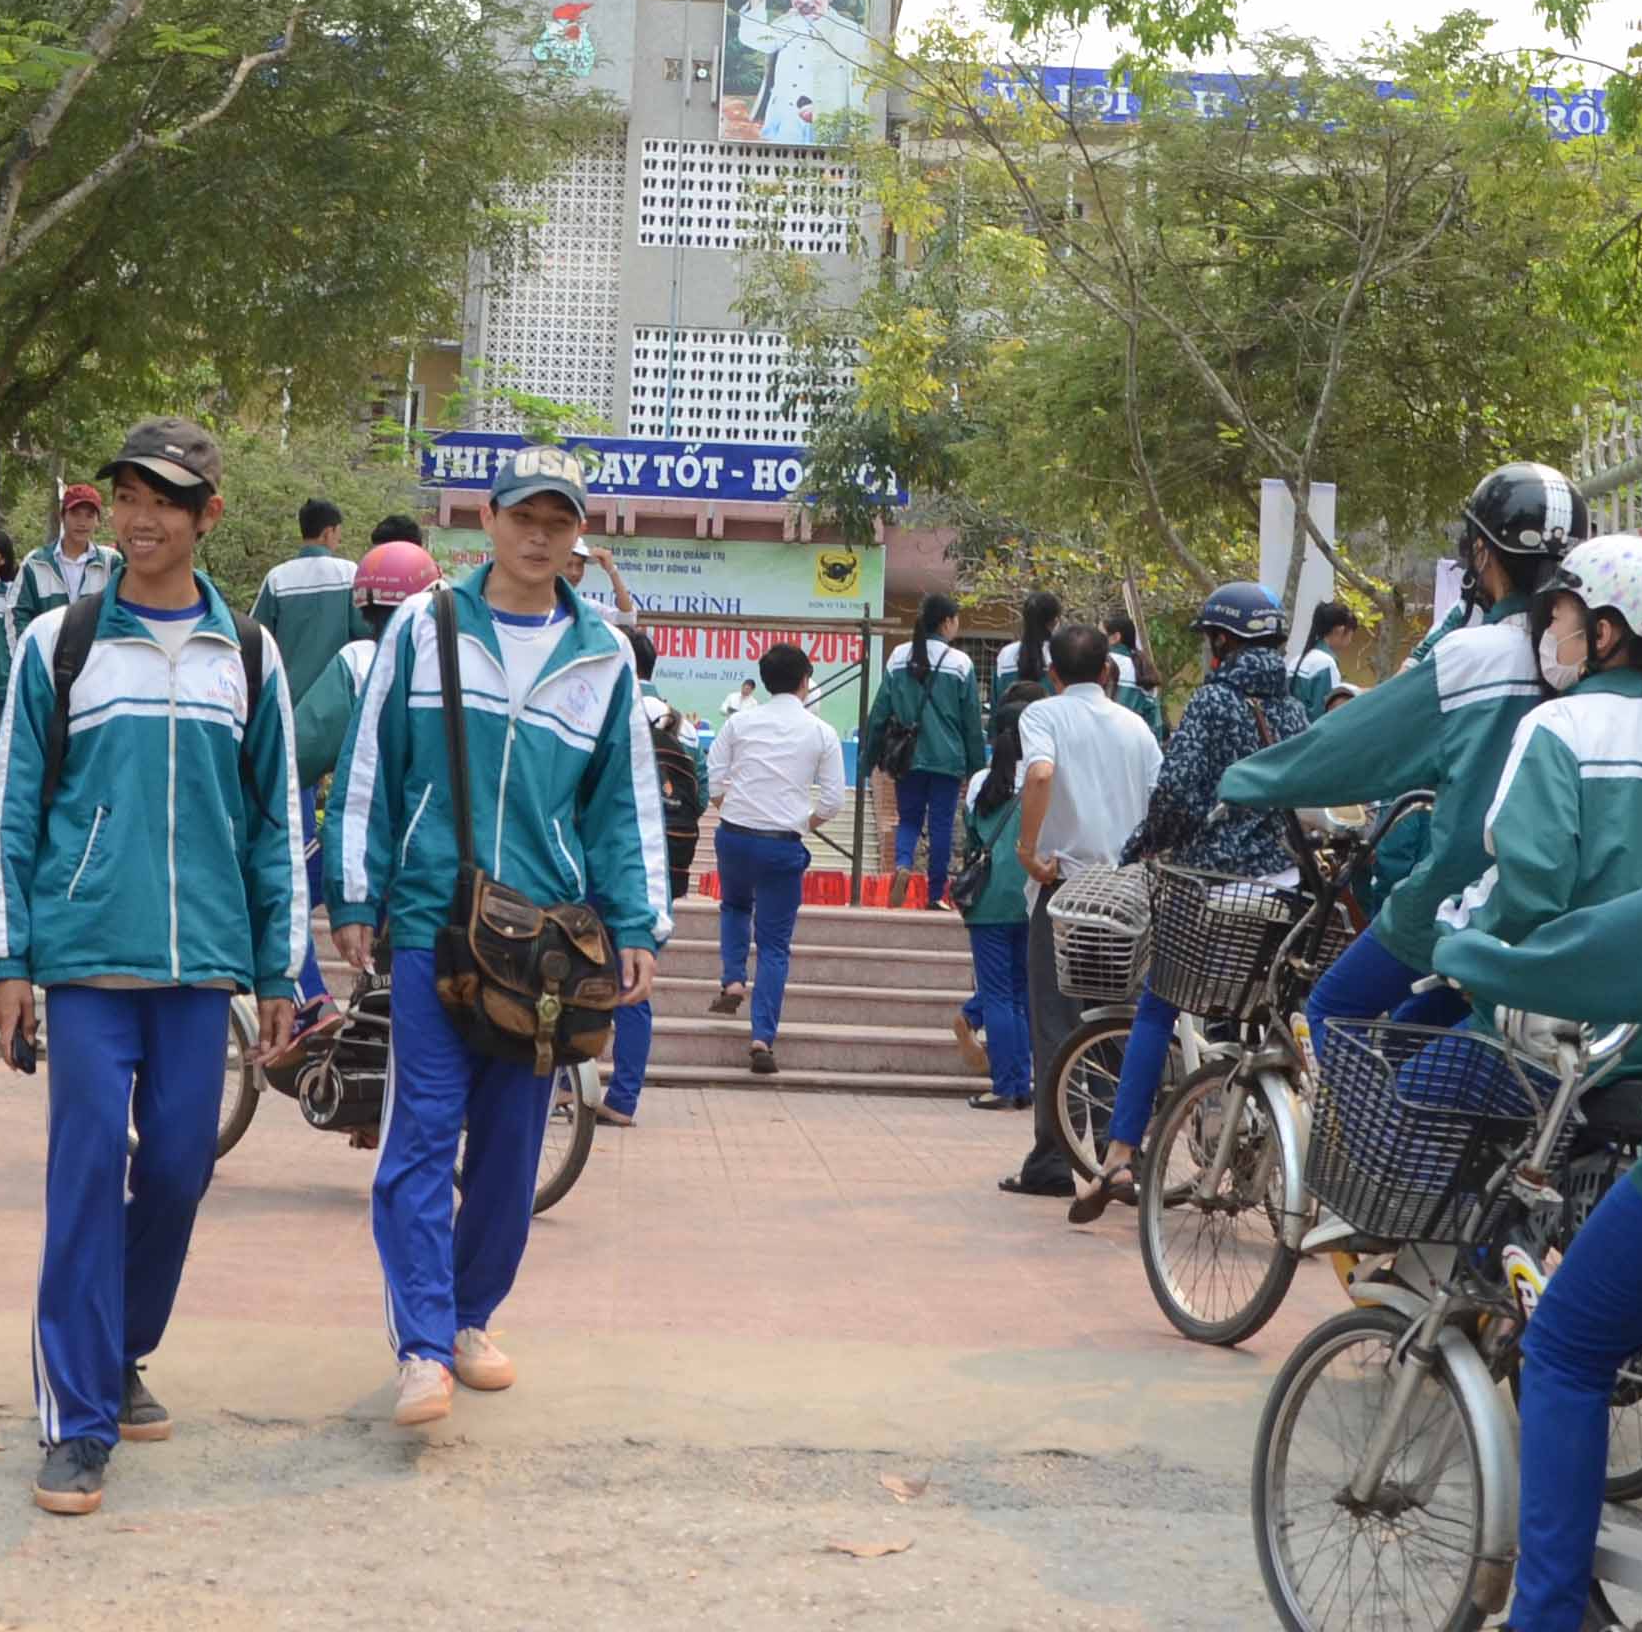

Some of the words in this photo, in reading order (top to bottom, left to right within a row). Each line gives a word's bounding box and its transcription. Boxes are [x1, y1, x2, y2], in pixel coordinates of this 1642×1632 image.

[431, 445, 488, 480] THI
[654, 443, 724, 490] TỐT
[514, 449, 581, 489] USA
[668, 591, 742, 615] TRÌNH
